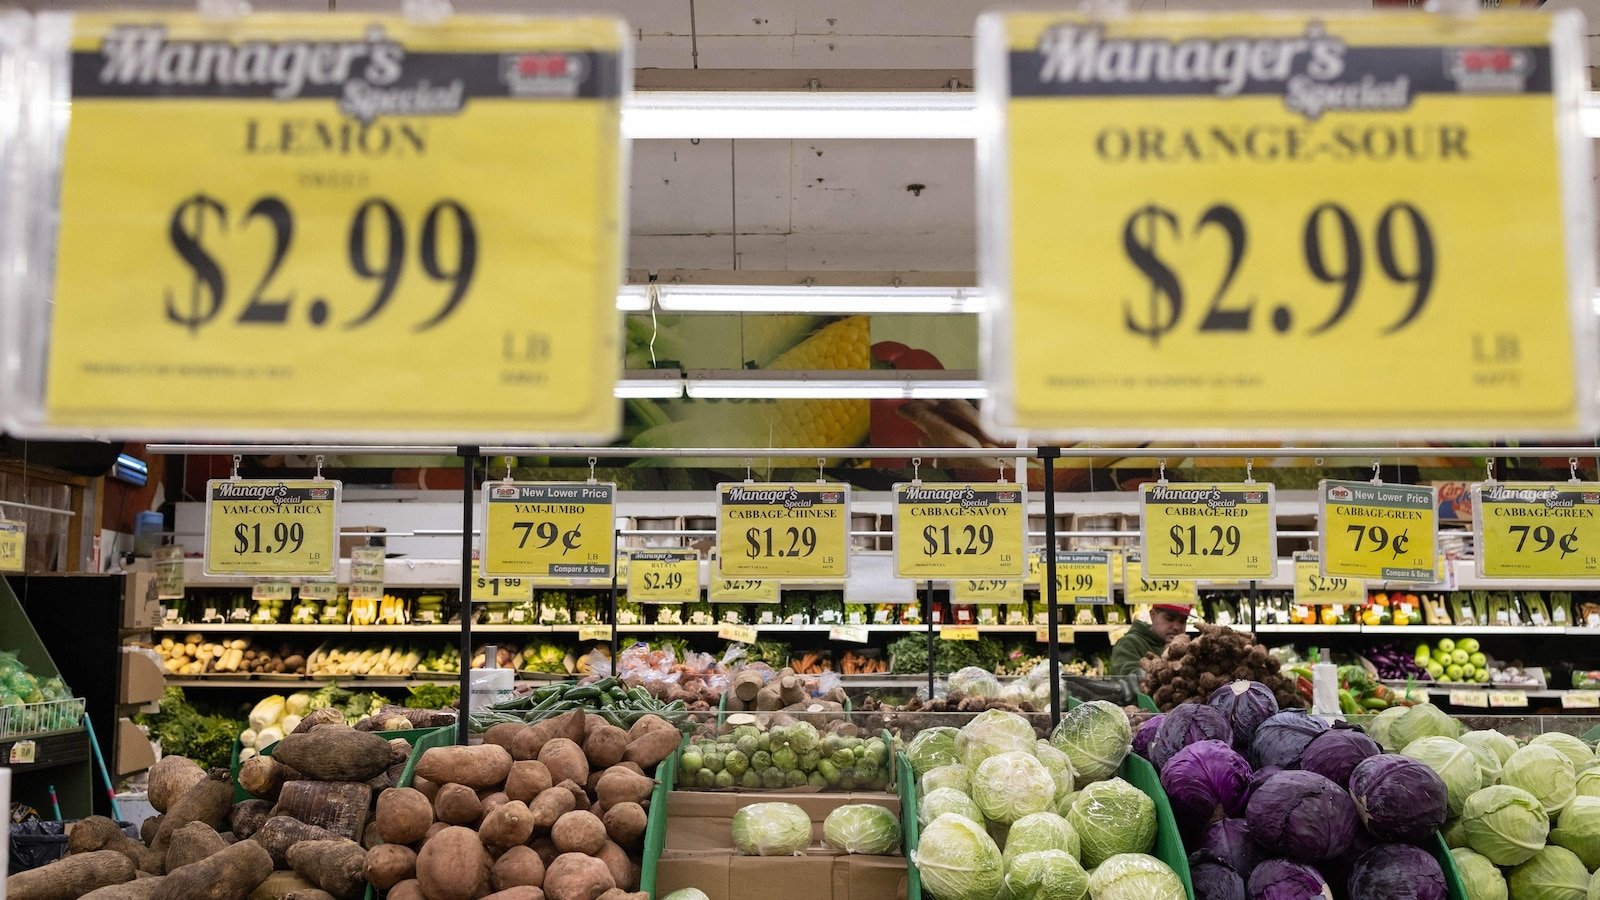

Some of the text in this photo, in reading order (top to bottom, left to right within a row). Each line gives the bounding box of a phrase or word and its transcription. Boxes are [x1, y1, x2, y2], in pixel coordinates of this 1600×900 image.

[101, 25, 403, 97] Manager's
[1037, 23, 1345, 95] Manager's
[343, 79, 465, 121] Special
[1286, 76, 1411, 117] Special
[244, 119, 427, 156] LEMON
[1095, 124, 1471, 162] ORANGE-SOUR
[165, 194, 479, 338] $2.99
[1121, 202, 1437, 346] $2.99
[501, 332, 551, 363] LB
[1472, 335, 1521, 363] LB
[220, 483, 287, 499] Manager's
[522, 488, 607, 498] New Lower Price
[729, 487, 798, 504] Manager's
[906, 486, 975, 503] Manager's
[1152, 486, 1221, 503] Manager's
[1355, 490, 1429, 503] New Lower Price
[1489, 486, 1559, 503] Manager's
[274, 496, 301, 505] Special
[784, 500, 812, 509] Special
[961, 499, 989, 508] Special
[1207, 500, 1236, 509] Special
[1545, 499, 1573, 508] Special
[223, 506, 321, 514] YAM-COSTA RICA
[515, 505, 585, 514] YAM-JUMBO
[729, 509, 837, 518] CABBAGE-CHINESE
[911, 507, 1008, 516] CABBAGE-SAVOY
[1165, 507, 1248, 517] CABBAGE-RED
[1336, 506, 1423, 520] CABBAGE-GREEN
[1495, 508, 1594, 518] CABBAGE-GREEN
[234, 522, 304, 555] $1.99
[746, 527, 817, 560] $1.29
[923, 524, 994, 557] $1.29
[1170, 524, 1240, 557] $1.29
[554, 565, 582, 574] Compare
[590, 565, 605, 573] Save
[1386, 569, 1410, 577] Compare
[1417, 570, 1429, 578] Save
[643, 572, 682, 590] $2.49
[1056, 573, 1093, 591] $1.99
